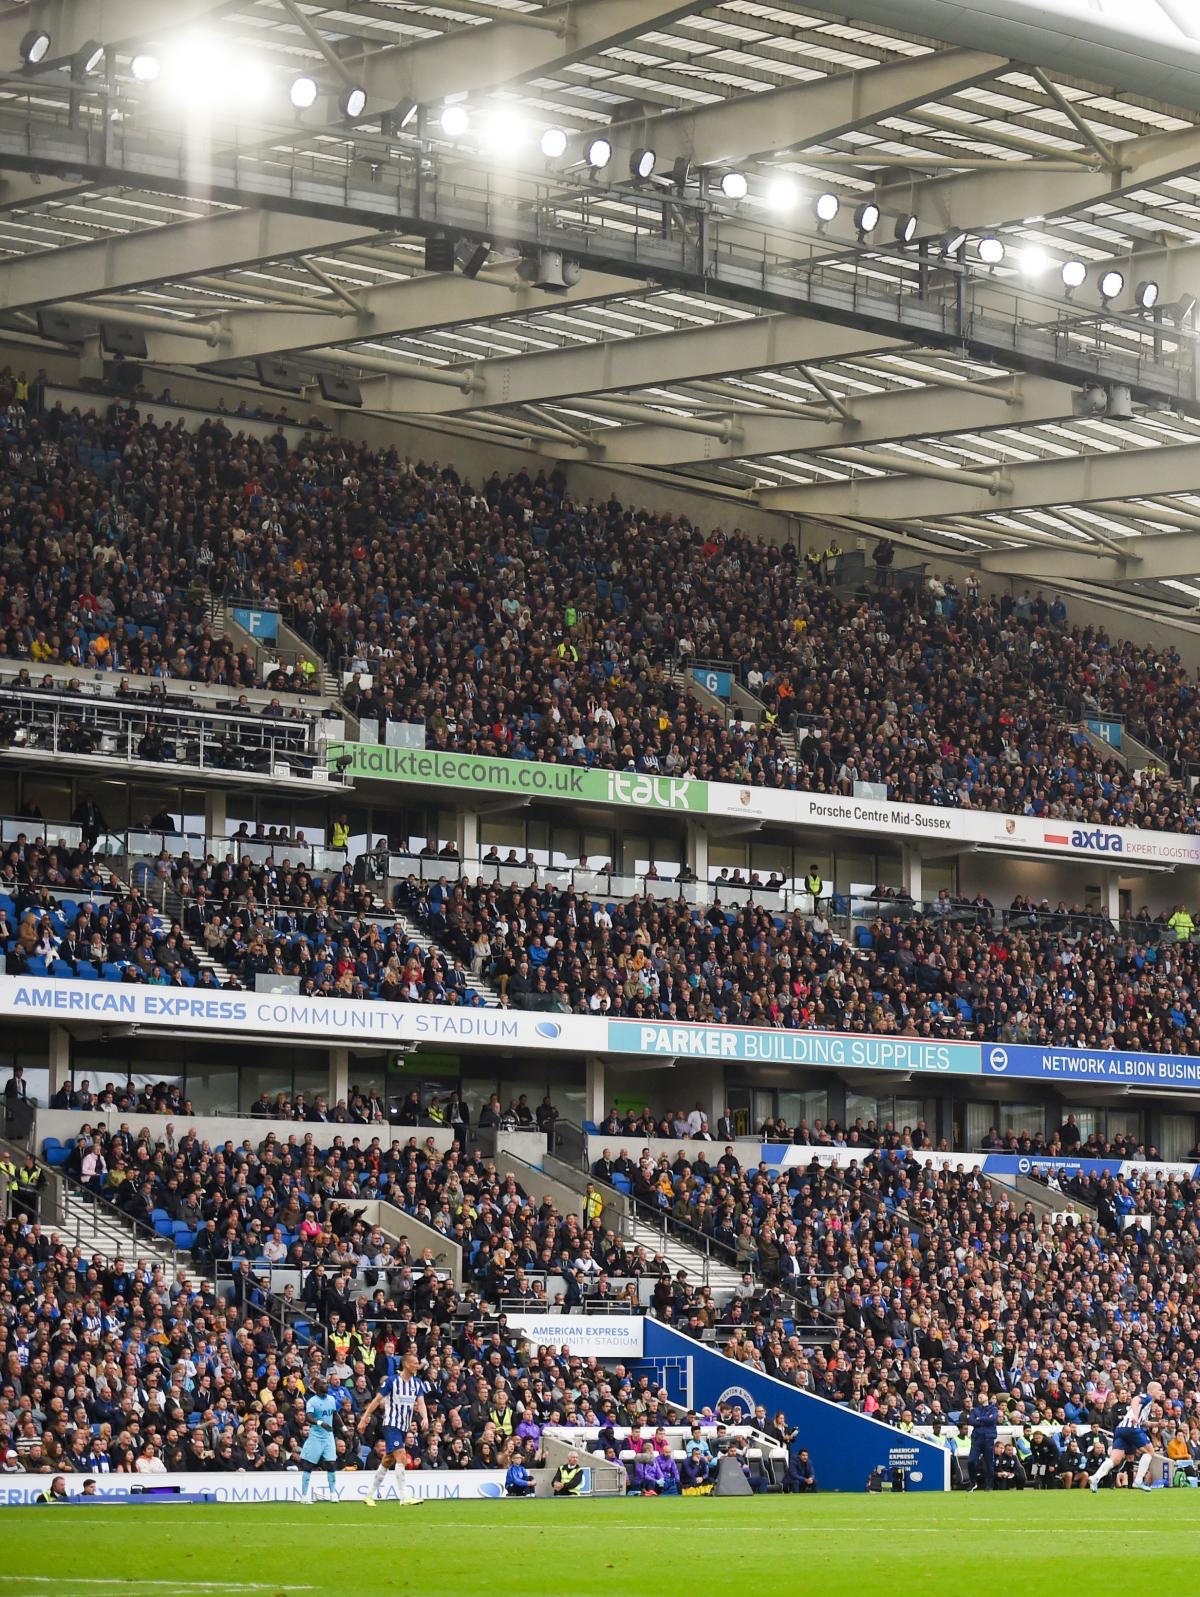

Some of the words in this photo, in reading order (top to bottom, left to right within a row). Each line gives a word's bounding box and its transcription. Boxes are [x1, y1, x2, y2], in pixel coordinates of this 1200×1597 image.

[250, 612, 261, 632] F
[707, 673, 718, 691] G
[1100, 724, 1110, 742] H
[809, 802, 852, 819] Porsche
[854, 808, 889, 823] Centre
[891, 810, 951, 829] Mid-Sussex
[1071, 828, 1123, 852] axtra
[1126, 843, 1157, 856] EXPERT
[1159, 845, 1200, 860] LOGISTICS
[13, 987, 136, 1013] AMERICAN
[143, 997, 247, 1020] EXPRESS
[257, 1004, 404, 1033] COMMUNITY
[416, 1016, 518, 1037] STADIUM
[640, 1026, 738, 1057] PARKER
[744, 1033, 845, 1064] BUILDING
[851, 1040, 950, 1070] SUPPLIES
[1042, 1055, 1105, 1074] NETWORK
[1108, 1059, 1155, 1077] ALBION
[532, 1327, 583, 1336] AMERICAN
[586, 1328, 629, 1336] EXPRESS
[595, 1337, 638, 1345] STADIUM
